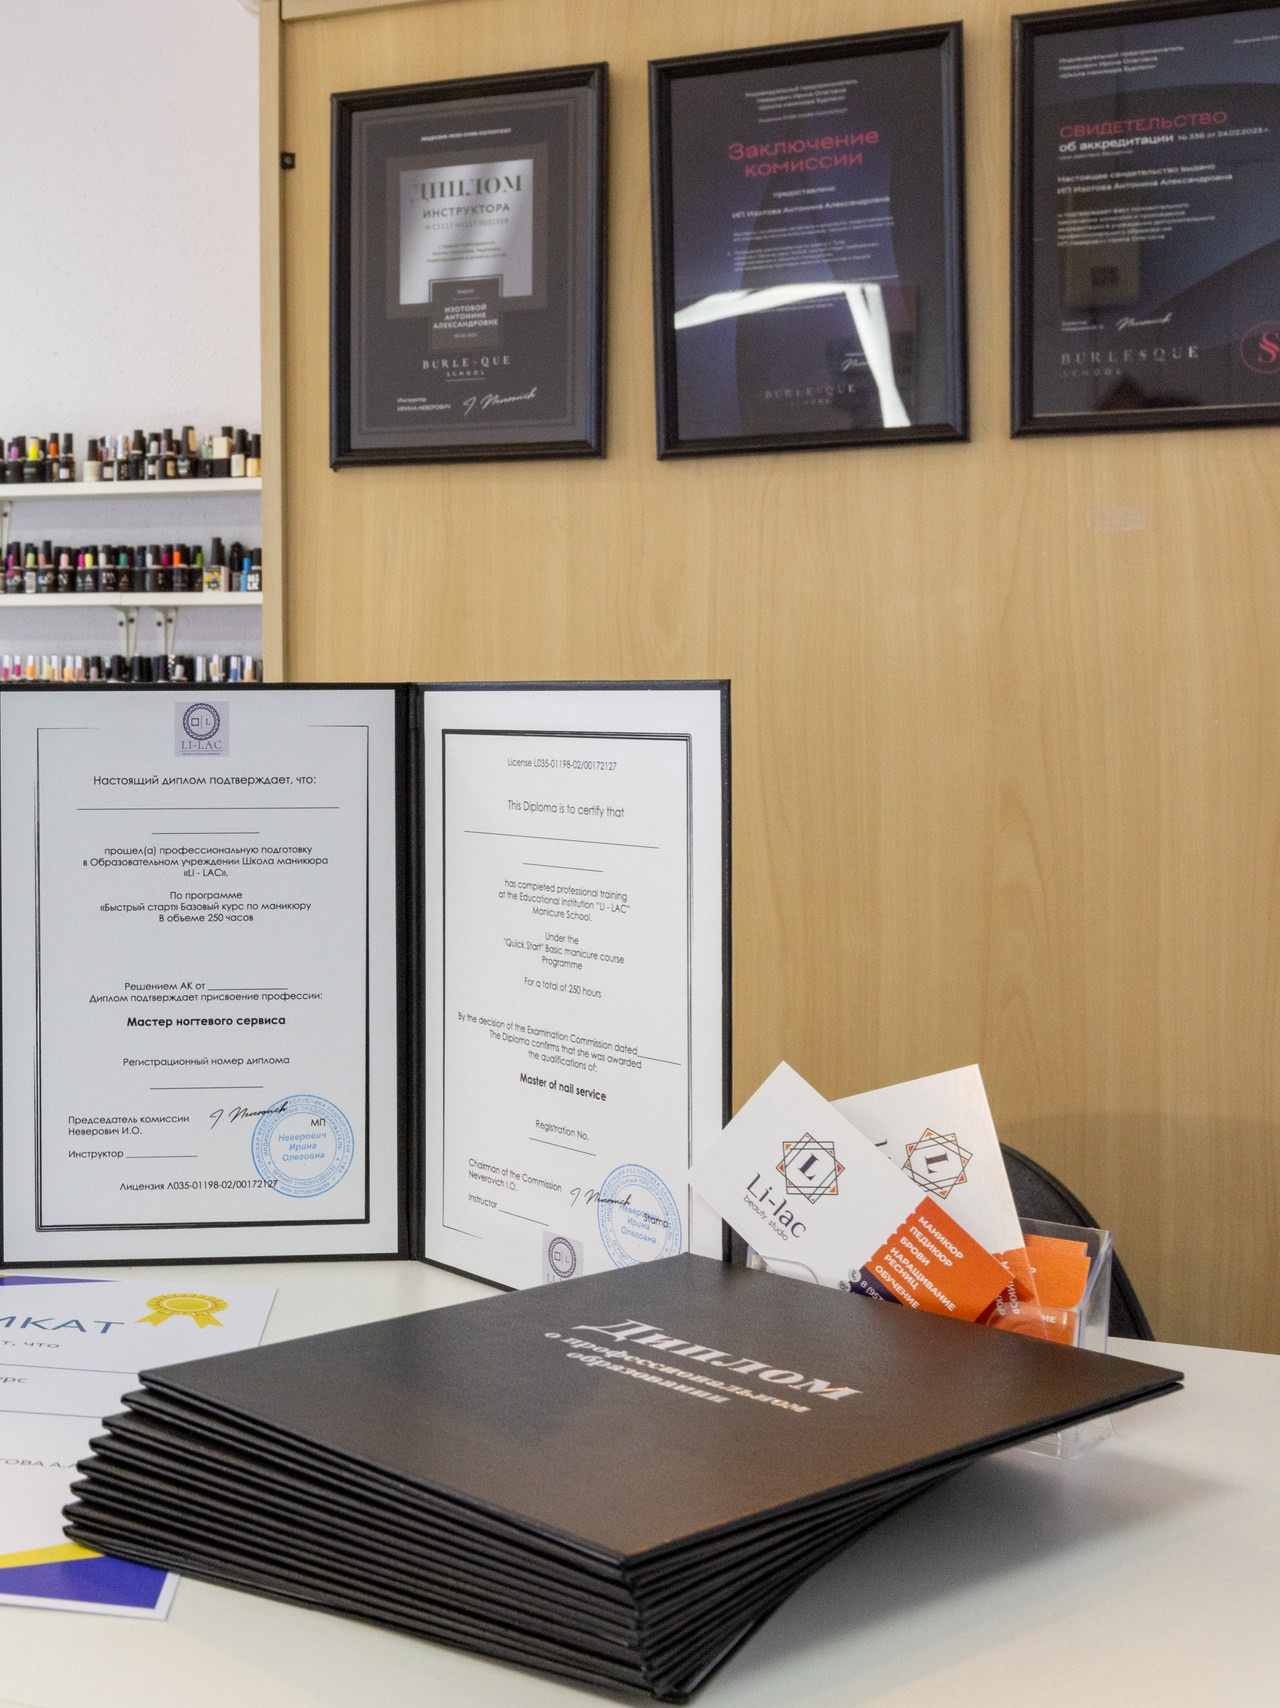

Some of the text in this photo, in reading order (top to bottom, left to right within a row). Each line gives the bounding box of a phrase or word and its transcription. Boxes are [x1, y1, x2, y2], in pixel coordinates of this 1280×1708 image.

[1059, 111, 1228, 139] СВИДЕТЕЛЬСТВО
[728, 130, 879, 160] Заключение
[1059, 141, 1077, 152] об
[1080, 135, 1174, 151] аккредитации
[744, 152, 863, 177] комиссии
[423, 203, 510, 219] ИНСТРУКТОРА
[444, 304, 487, 313] ИЗОТОВОЙ
[433, 319, 498, 329] АЛЕКСАНДРОВНЕ
[1061, 346, 1198, 364] BURLESQUE
[181, 740, 222, 750] LI-LAC
[508, 758, 532, 767] License
[94, 775, 159, 785] Настоящий
[162, 777, 206, 785] диплом
[210, 777, 293, 786] подтверждает,
[100, 903, 145, 913] «Быстрый
[148, 904, 178, 912] старт»
[181, 902, 219, 911] Базовый
[222, 904, 244, 912] курс
[261, 903, 311, 911] маникюру
[159, 914, 164, 922] В
[167, 914, 205, 922] объеме
[208, 913, 224, 922] 250
[545, 944, 563, 955] Basic
[564, 949, 598, 960] manicure
[600, 954, 624, 964] course
[89, 992, 322, 1003] Диплом подтверждает присвоение профессии:
[127, 1017, 285, 1028] Мастер ногтевого сервиса
[123, 1057, 208, 1067] Регистрационный
[211, 1058, 244, 1066] номер
[520, 1073, 606, 1101] Master of nail service
[69, 1116, 138, 1126] Председатель
[311, 1118, 326, 1126] МП
[69, 1126, 142, 1137] Неверович И.О.
[278, 1132, 326, 1141] Неверович
[69, 1150, 124, 1159] Инструктор
[289, 1142, 317, 1151] Ирина
[282, 1152, 325, 1162] Олеговна
[798, 1153, 819, 1181] L
[120, 1182, 164, 1192] Лицензия
[747, 1172, 806, 1238] Li-lac
[744, 1195, 788, 1241] beauty studio
[919, 1217, 964, 1259] МАНИКЮР
[900, 1236, 930, 1266] БРОВИ
[910, 1226, 953, 1267] ПЕДИКЮР
[884, 1254, 919, 1290] РЕСНИЦ
[890, 1248, 956, 1311] НАРАЩИВАНИЕ
[875, 1266, 919, 1309] ОБУЧЕНИЕ
[23, 1341, 59, 1349] что
[571, 1319, 863, 1401] Диплом
[545, 1331, 811, 1413] о профессиональном
[566, 1352, 731, 1404] образовании
